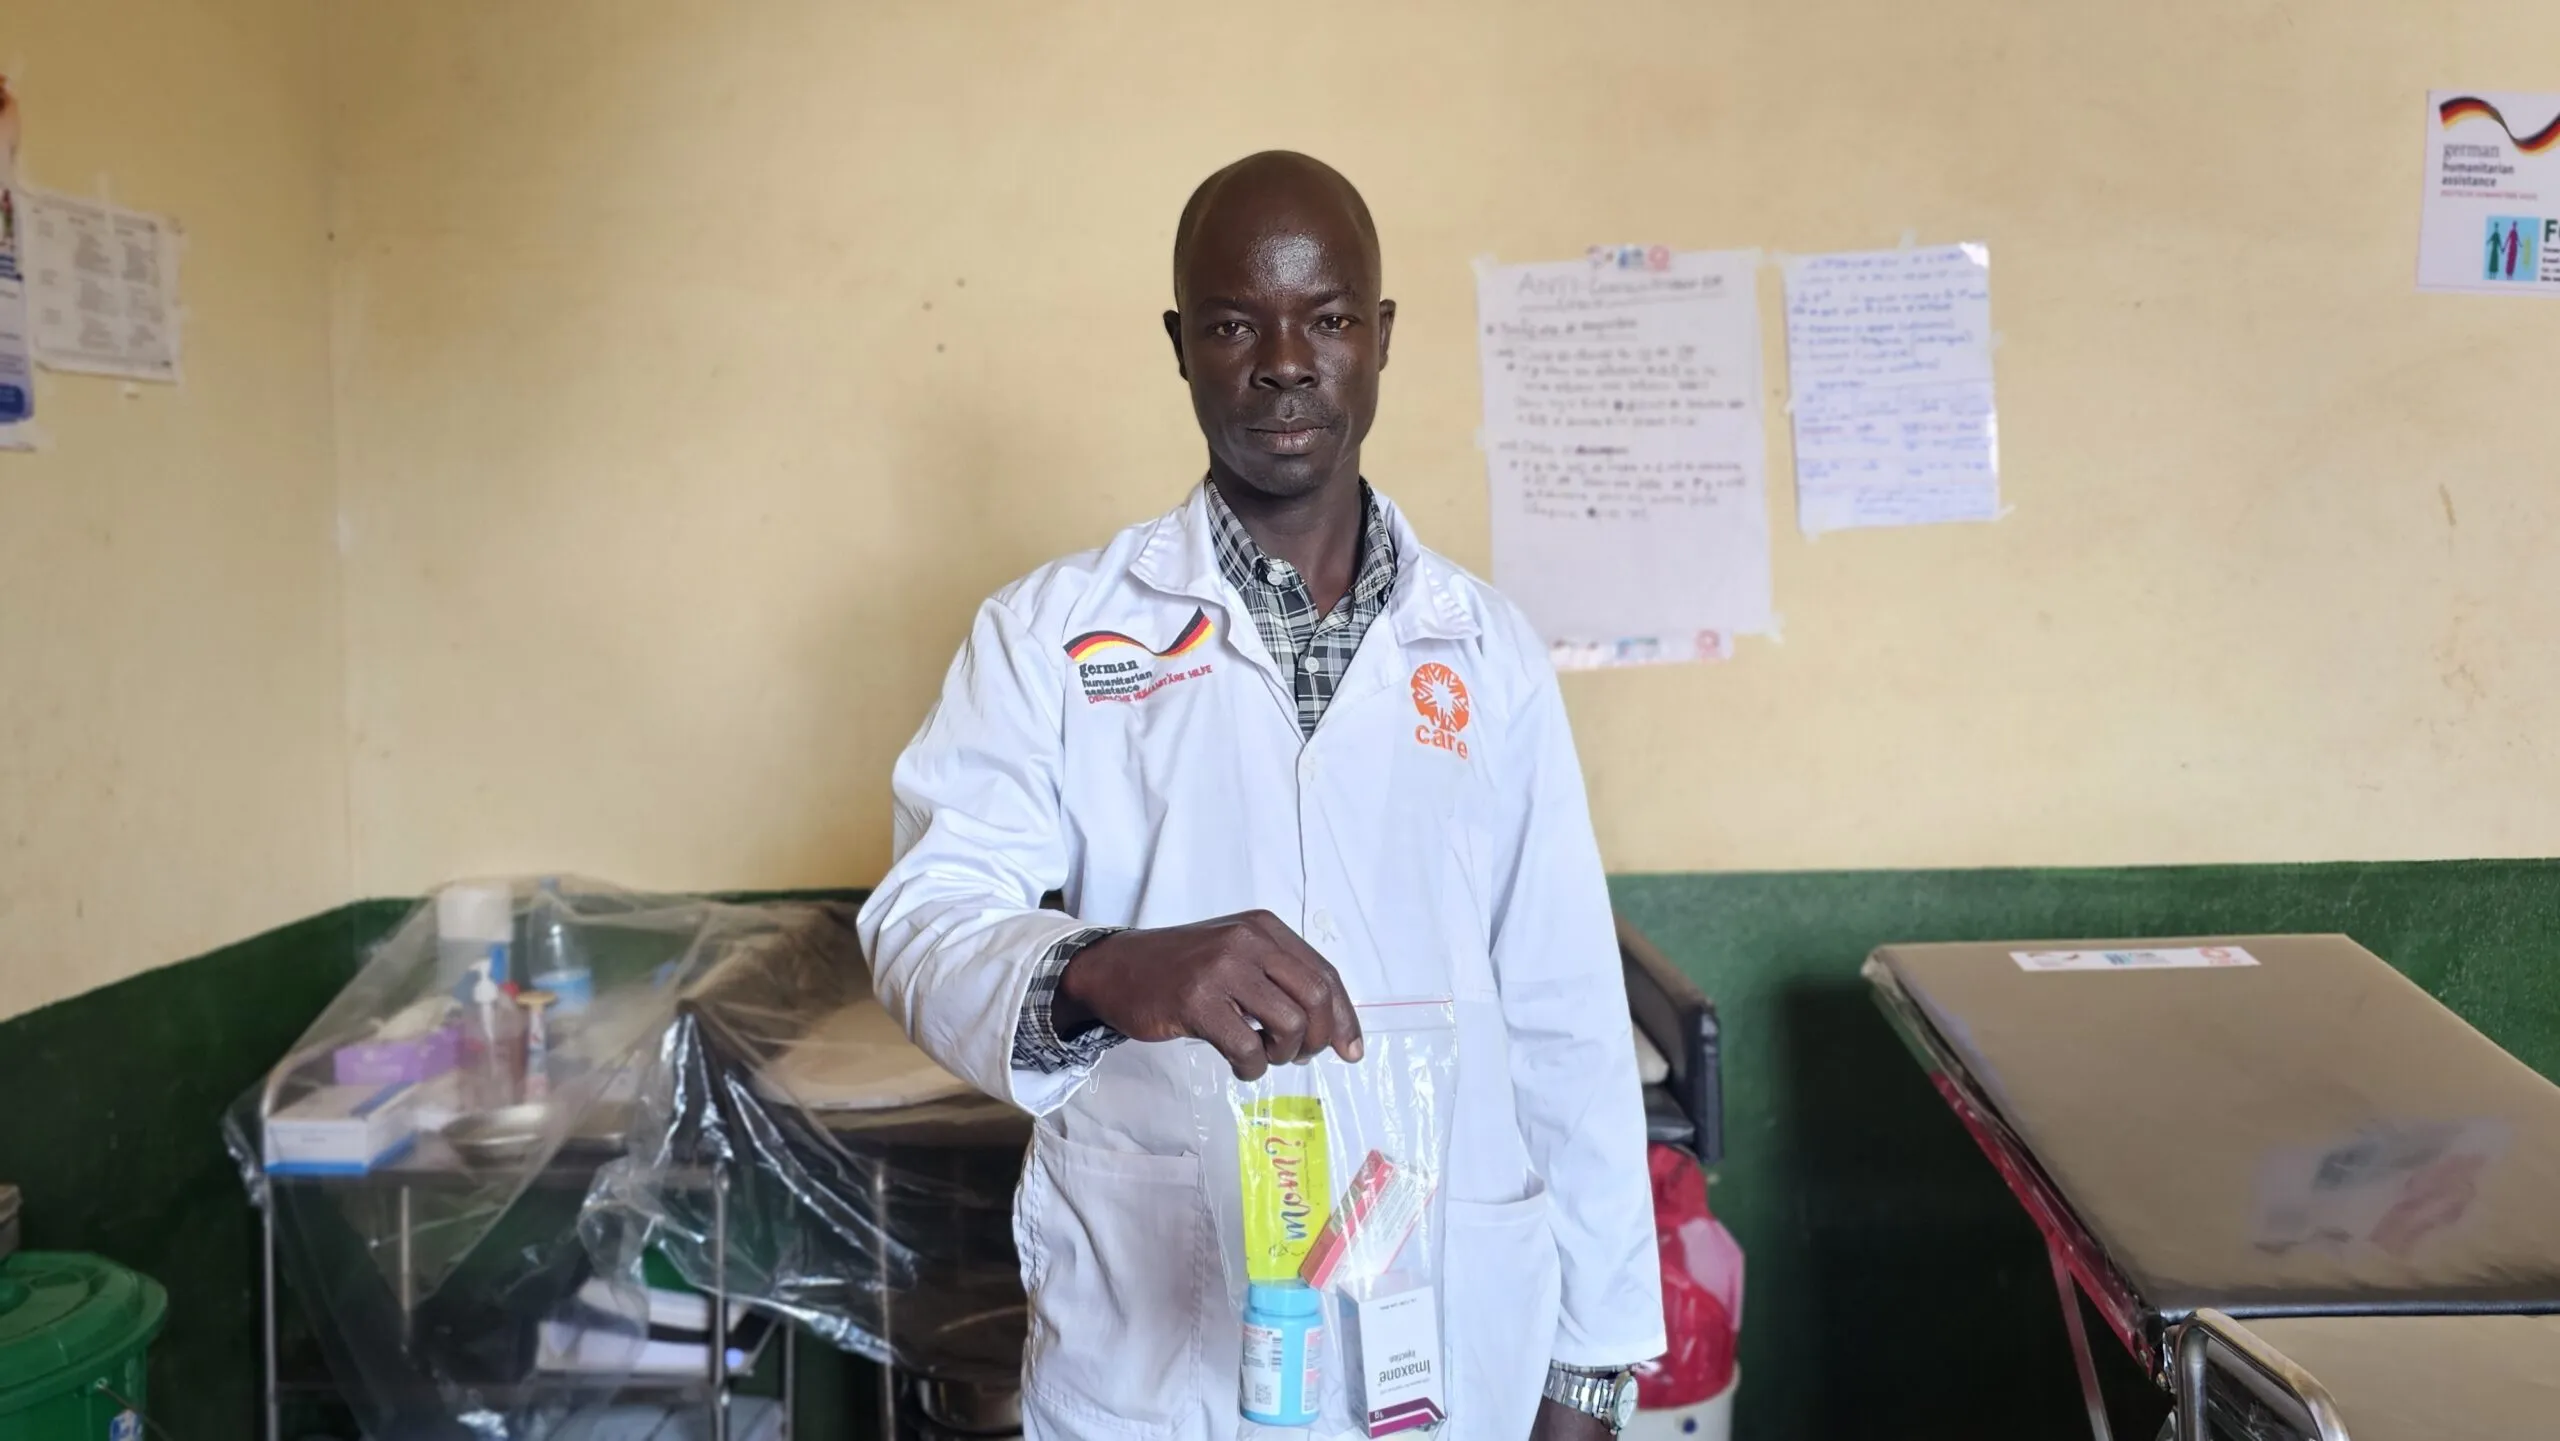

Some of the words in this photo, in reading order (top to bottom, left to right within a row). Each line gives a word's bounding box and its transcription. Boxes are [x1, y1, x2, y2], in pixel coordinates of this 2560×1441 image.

[2443, 144, 2500, 160] german
[2442, 162, 2514, 174] humanitarian
[2442, 176, 2497, 187] assistance
[2544, 218, 2560, 243] F
[1079, 659, 1139, 679] german
[1188, 664, 1213, 679] HILFE
[1081, 670, 1153, 688] humanitarian
[1085, 684, 1140, 697] assistance
[1415, 724, 1468, 760] care
[1379, 1359, 1431, 1384] Imaxone
